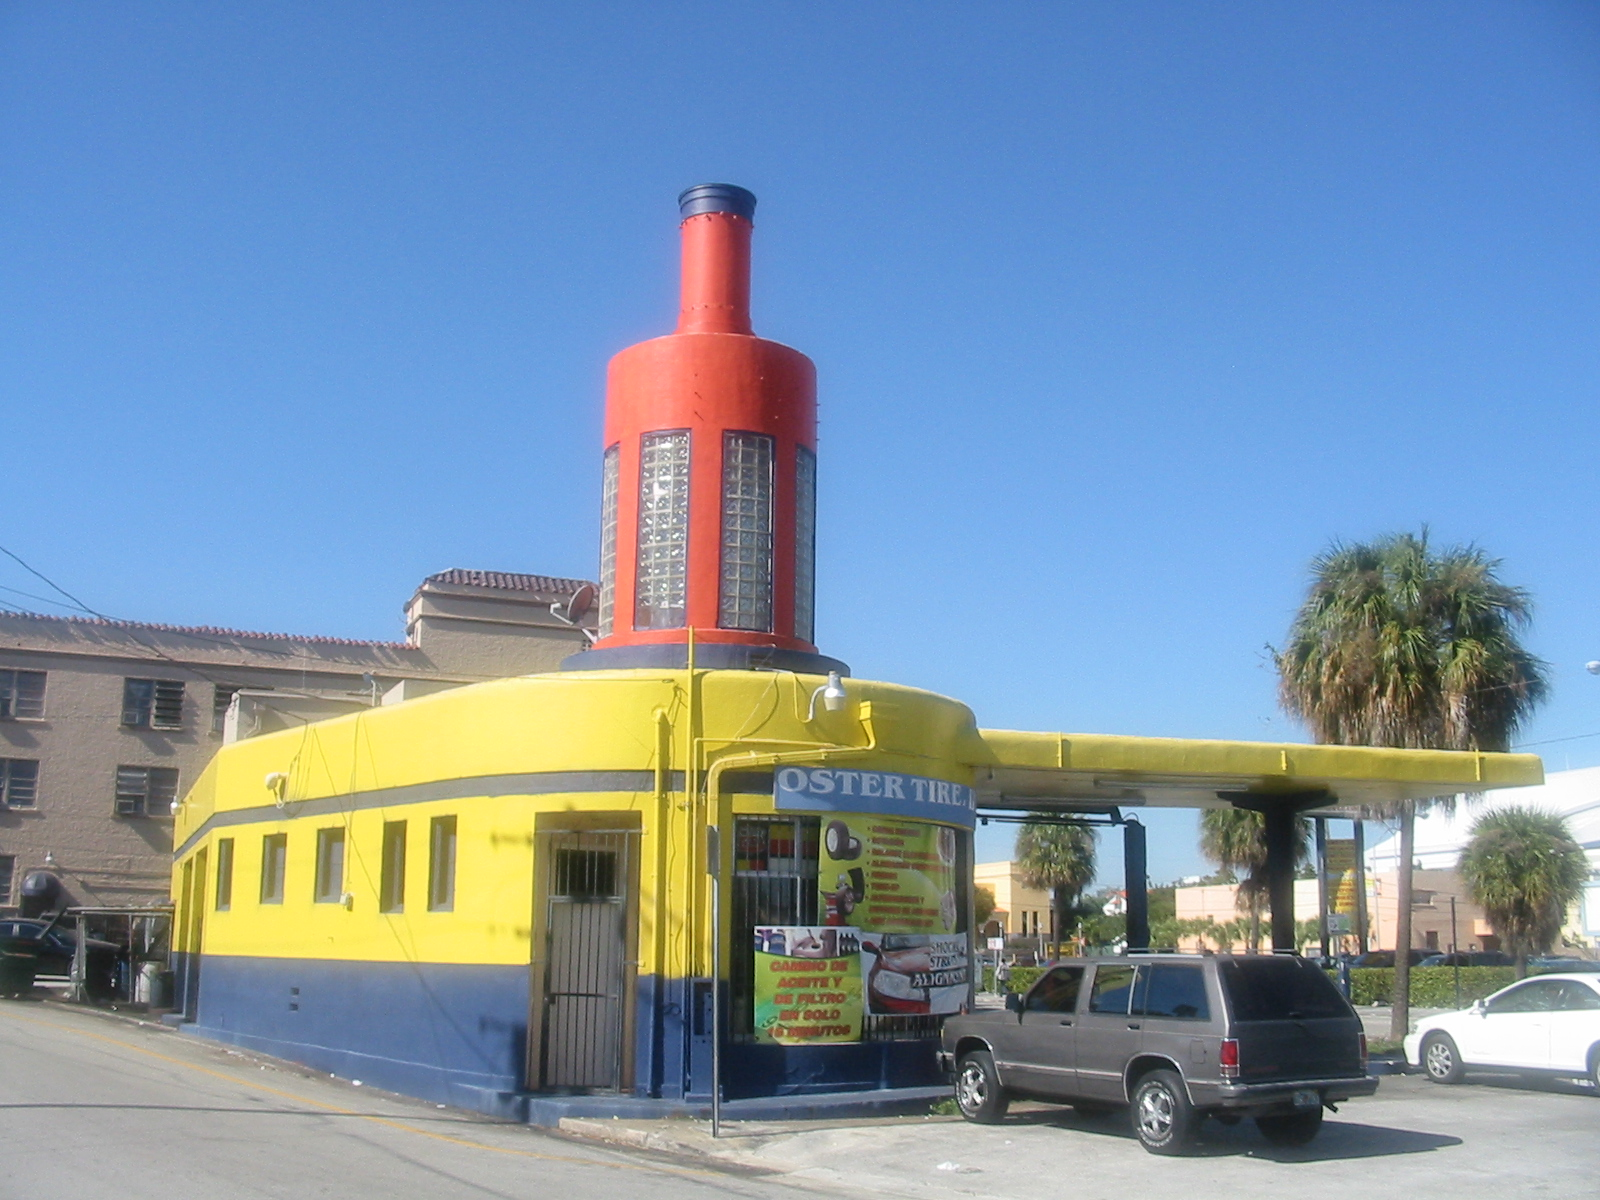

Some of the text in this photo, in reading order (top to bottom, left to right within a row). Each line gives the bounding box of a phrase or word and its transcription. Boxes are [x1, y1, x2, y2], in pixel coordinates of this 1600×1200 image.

[777, 767, 906, 800] OSTER
[770, 960, 849, 972] CAMBIO DE
[777, 976, 844, 988] ACEITE Y
[774, 993, 847, 1005] DE FILTRO
[803, 1009, 841, 1020] SOLO
[788, 1025, 851, 1038] MINUTOS
